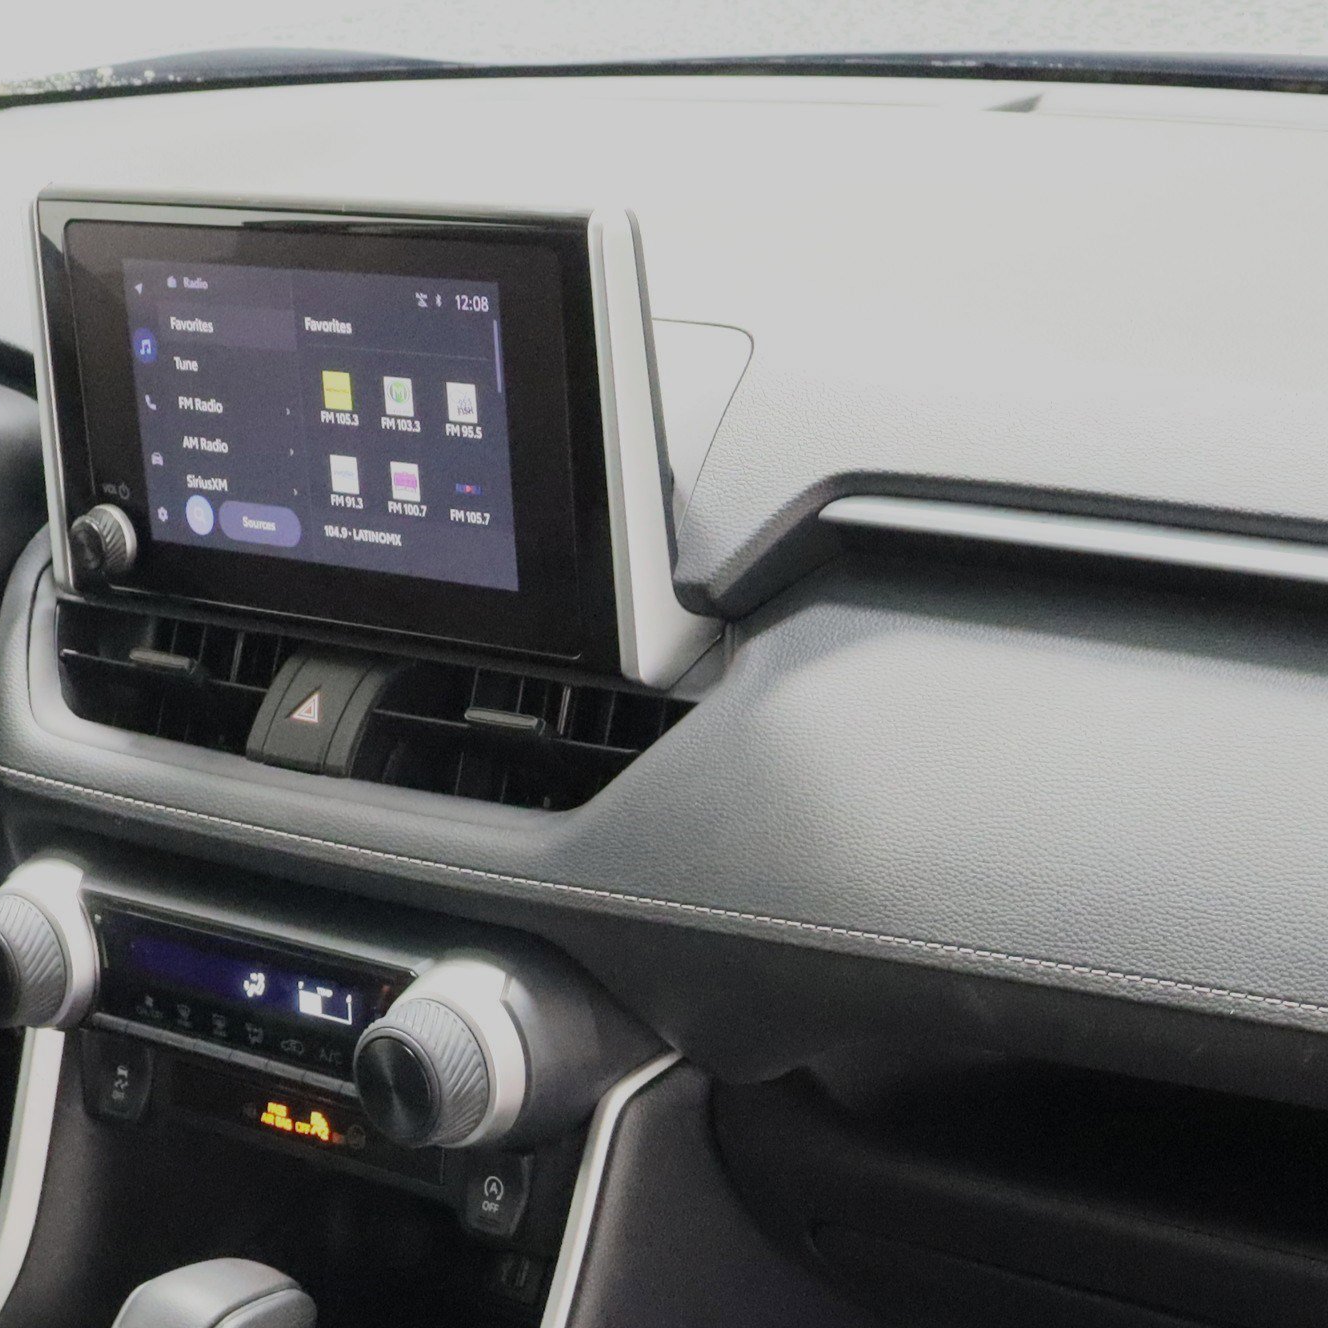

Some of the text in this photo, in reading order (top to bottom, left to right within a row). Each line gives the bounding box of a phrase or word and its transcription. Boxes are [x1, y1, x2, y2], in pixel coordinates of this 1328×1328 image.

[183, 277, 208, 290] Radio
[455, 294, 489, 312] 12:08
[170, 316, 214, 333] Favorites
[304, 316, 352, 334] Favorites
[173, 356, 199, 372] Tune
[178, 396, 223, 413] FM Radio
[321, 410, 359, 426] FM 105.3
[381, 416, 421, 433] FM 103.3
[445, 423, 482, 439] FM 95.5
[183, 436, 228, 453] AM Radio
[186, 474, 228, 492] SiriusXM
[330, 494, 364, 509] FM 91.3
[388, 501, 427, 517] FM 100.7
[242, 516, 276, 531] Sources
[450, 509, 490, 526] FM 105.7
[324, 525, 402, 547] 104.9 LATINOMX
[482, 1200, 500, 1213] OFF
